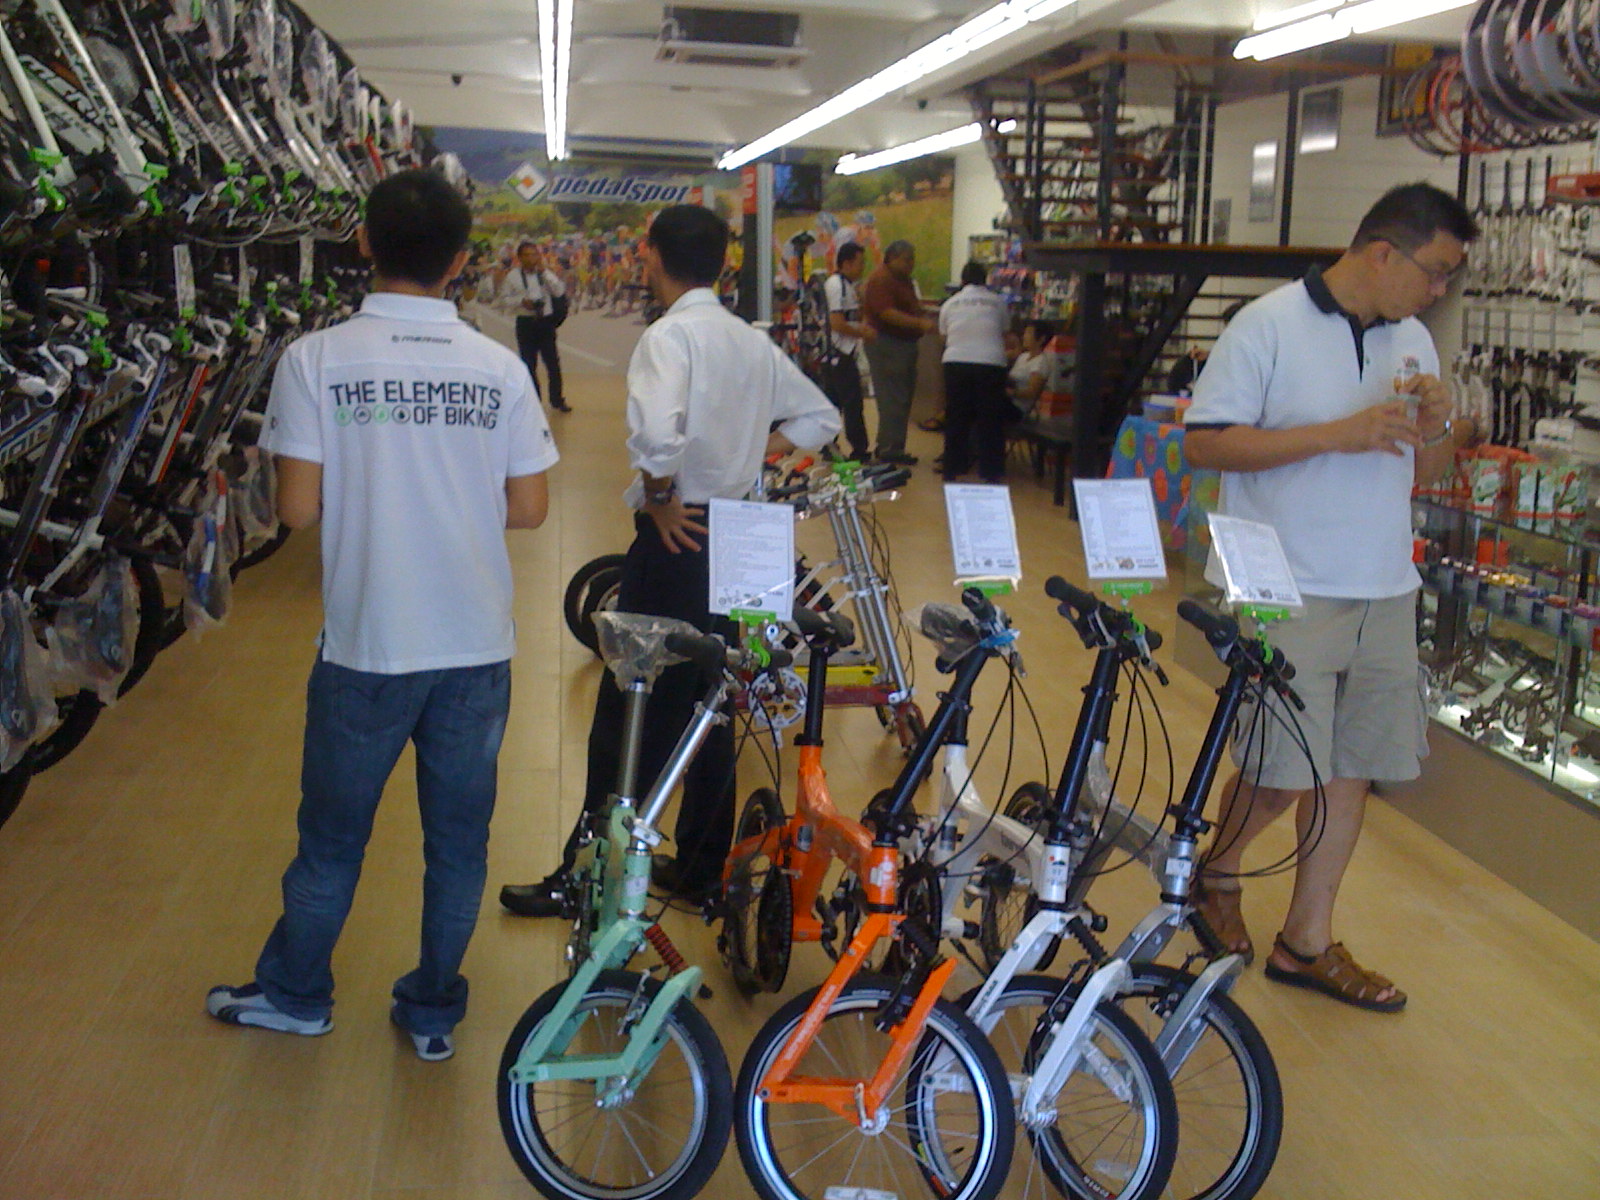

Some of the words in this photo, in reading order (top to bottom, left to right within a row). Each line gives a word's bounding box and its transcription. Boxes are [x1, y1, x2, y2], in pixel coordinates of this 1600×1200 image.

[329, 380, 376, 406] THE
[384, 380, 502, 410] ELEMENTS
[413, 405, 438, 425] OF
